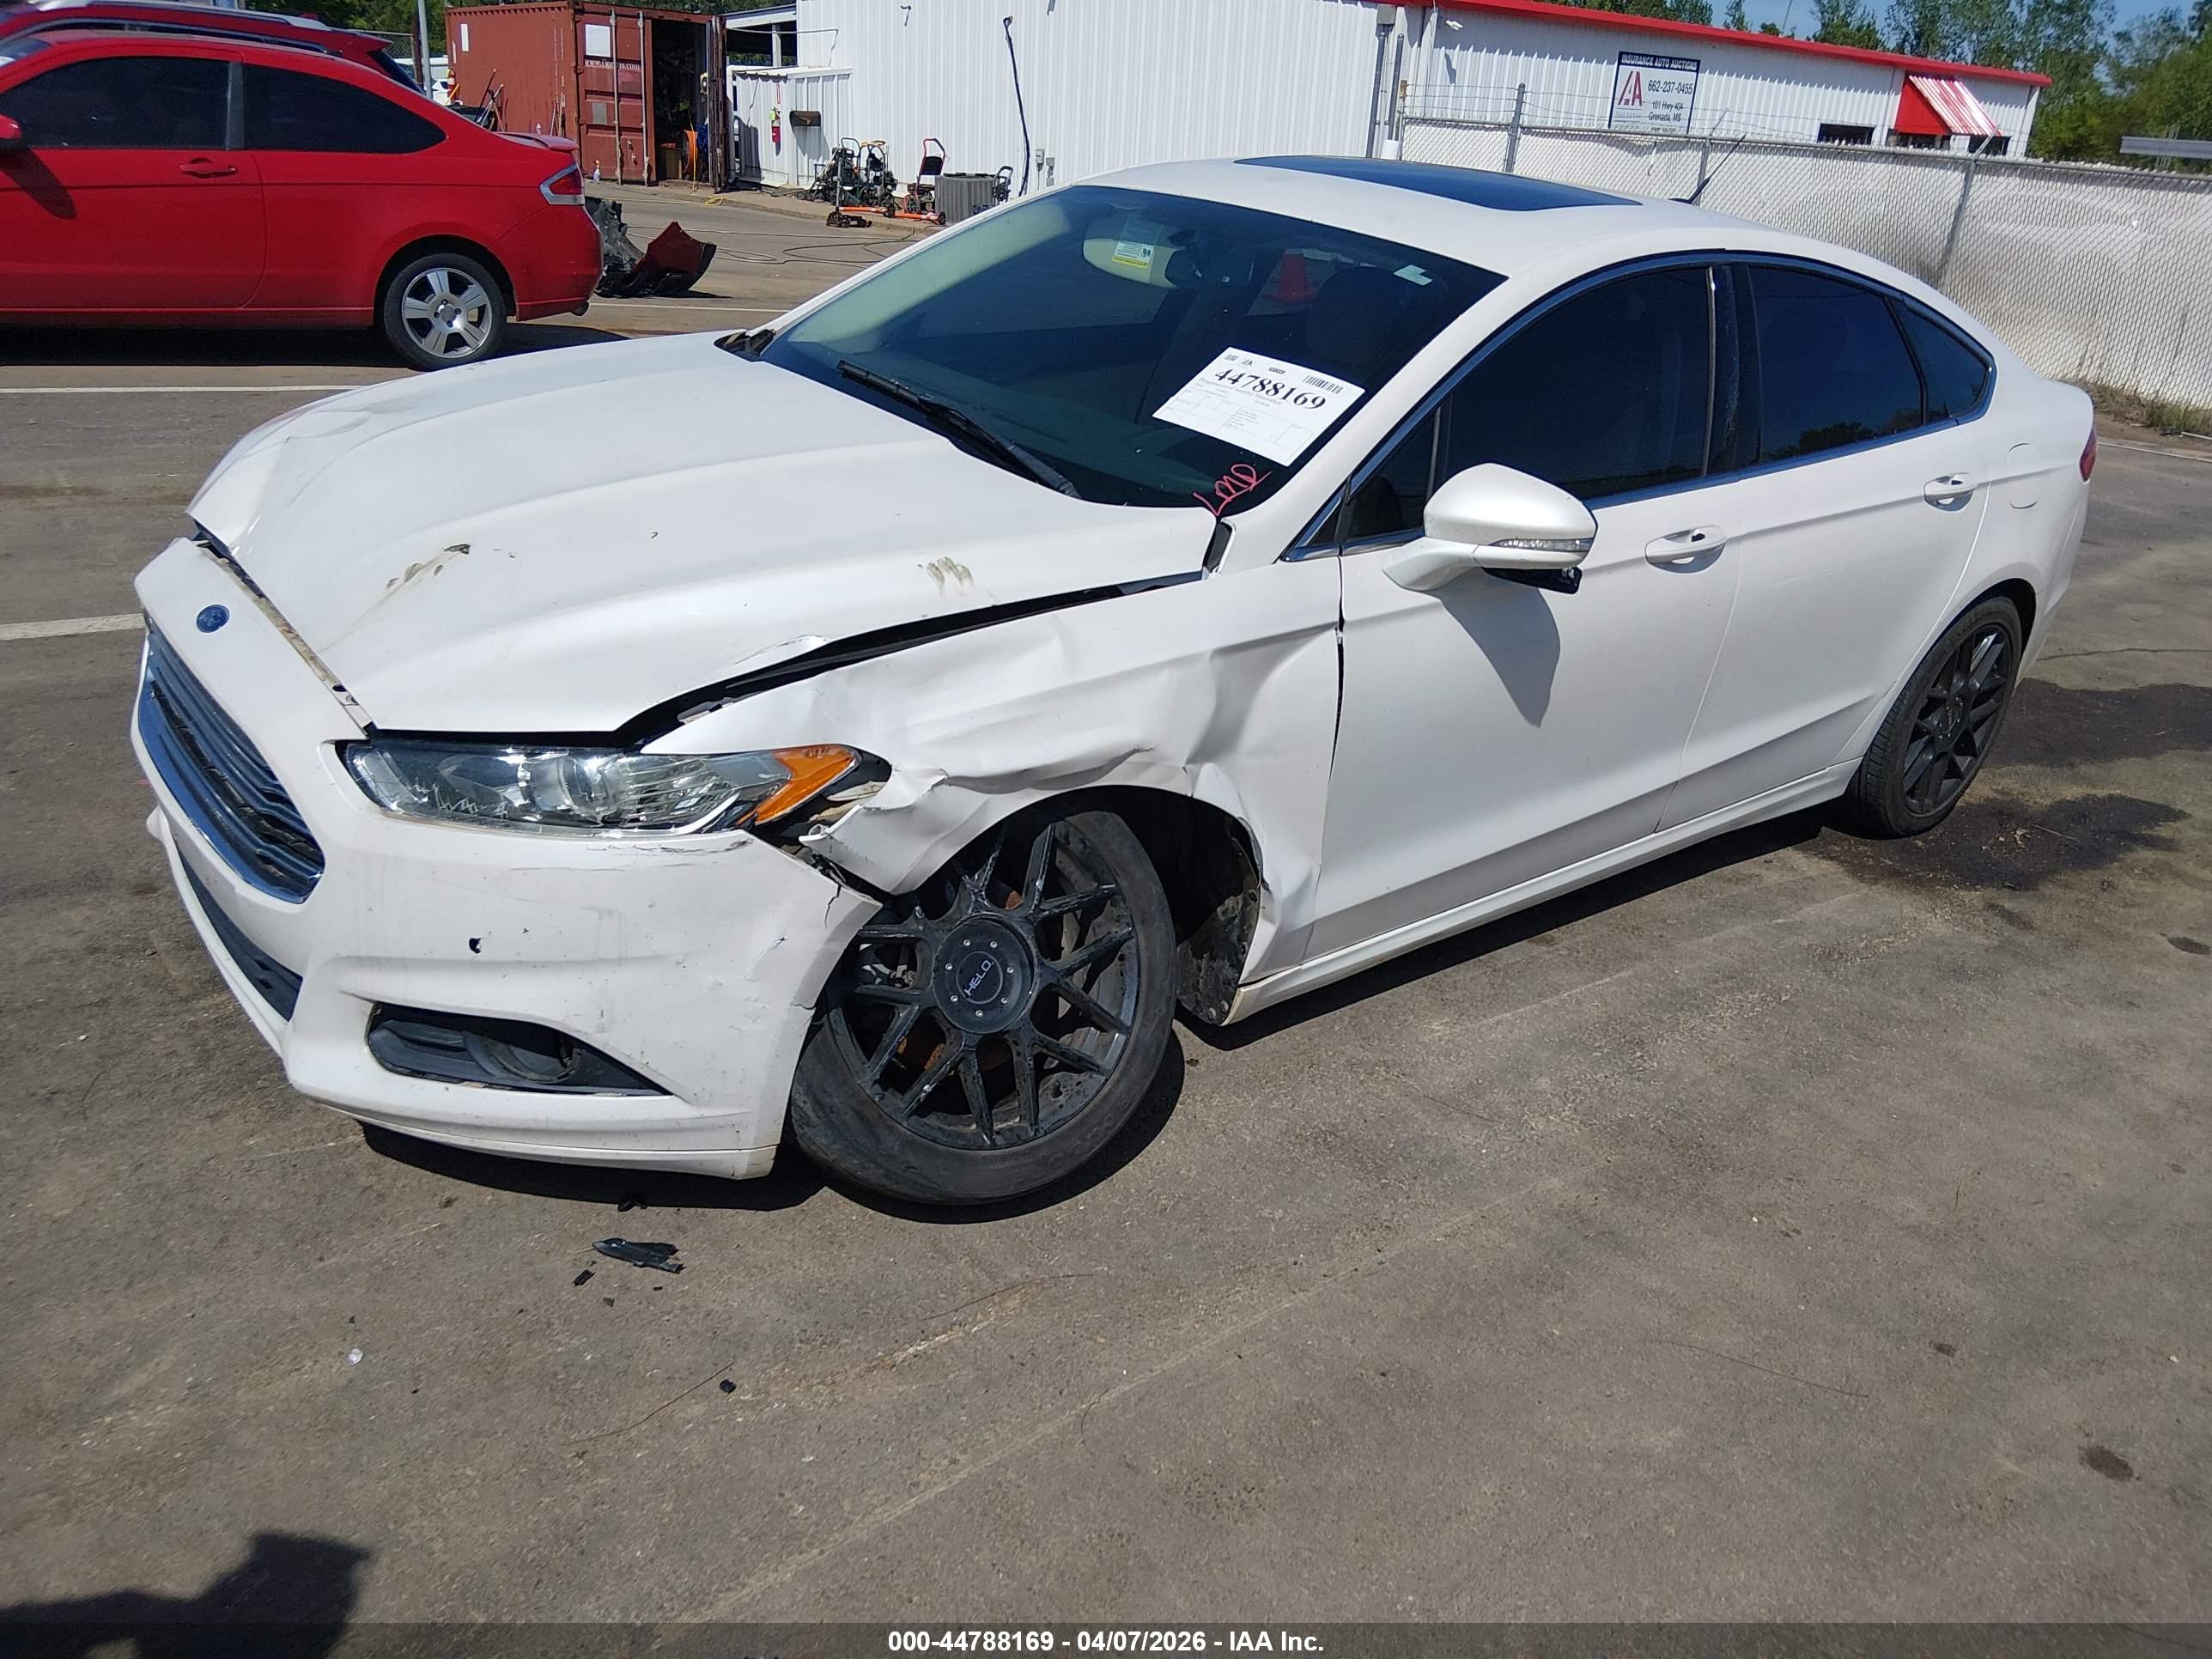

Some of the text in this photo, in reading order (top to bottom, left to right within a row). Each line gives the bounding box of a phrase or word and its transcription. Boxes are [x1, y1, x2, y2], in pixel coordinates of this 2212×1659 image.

[1621, 54, 1698, 70] INSURANCE AUTO AUCTIONS
[1648, 80, 1692, 94] 662-237-0455
[1662, 100, 1673, 112] Hwy
[1649, 112, 1671, 122] Grenada,
[1673, 113, 1681, 122] MS
[1214, 369, 1326, 409] 44788169
[964, 960, 992, 996] HELO
